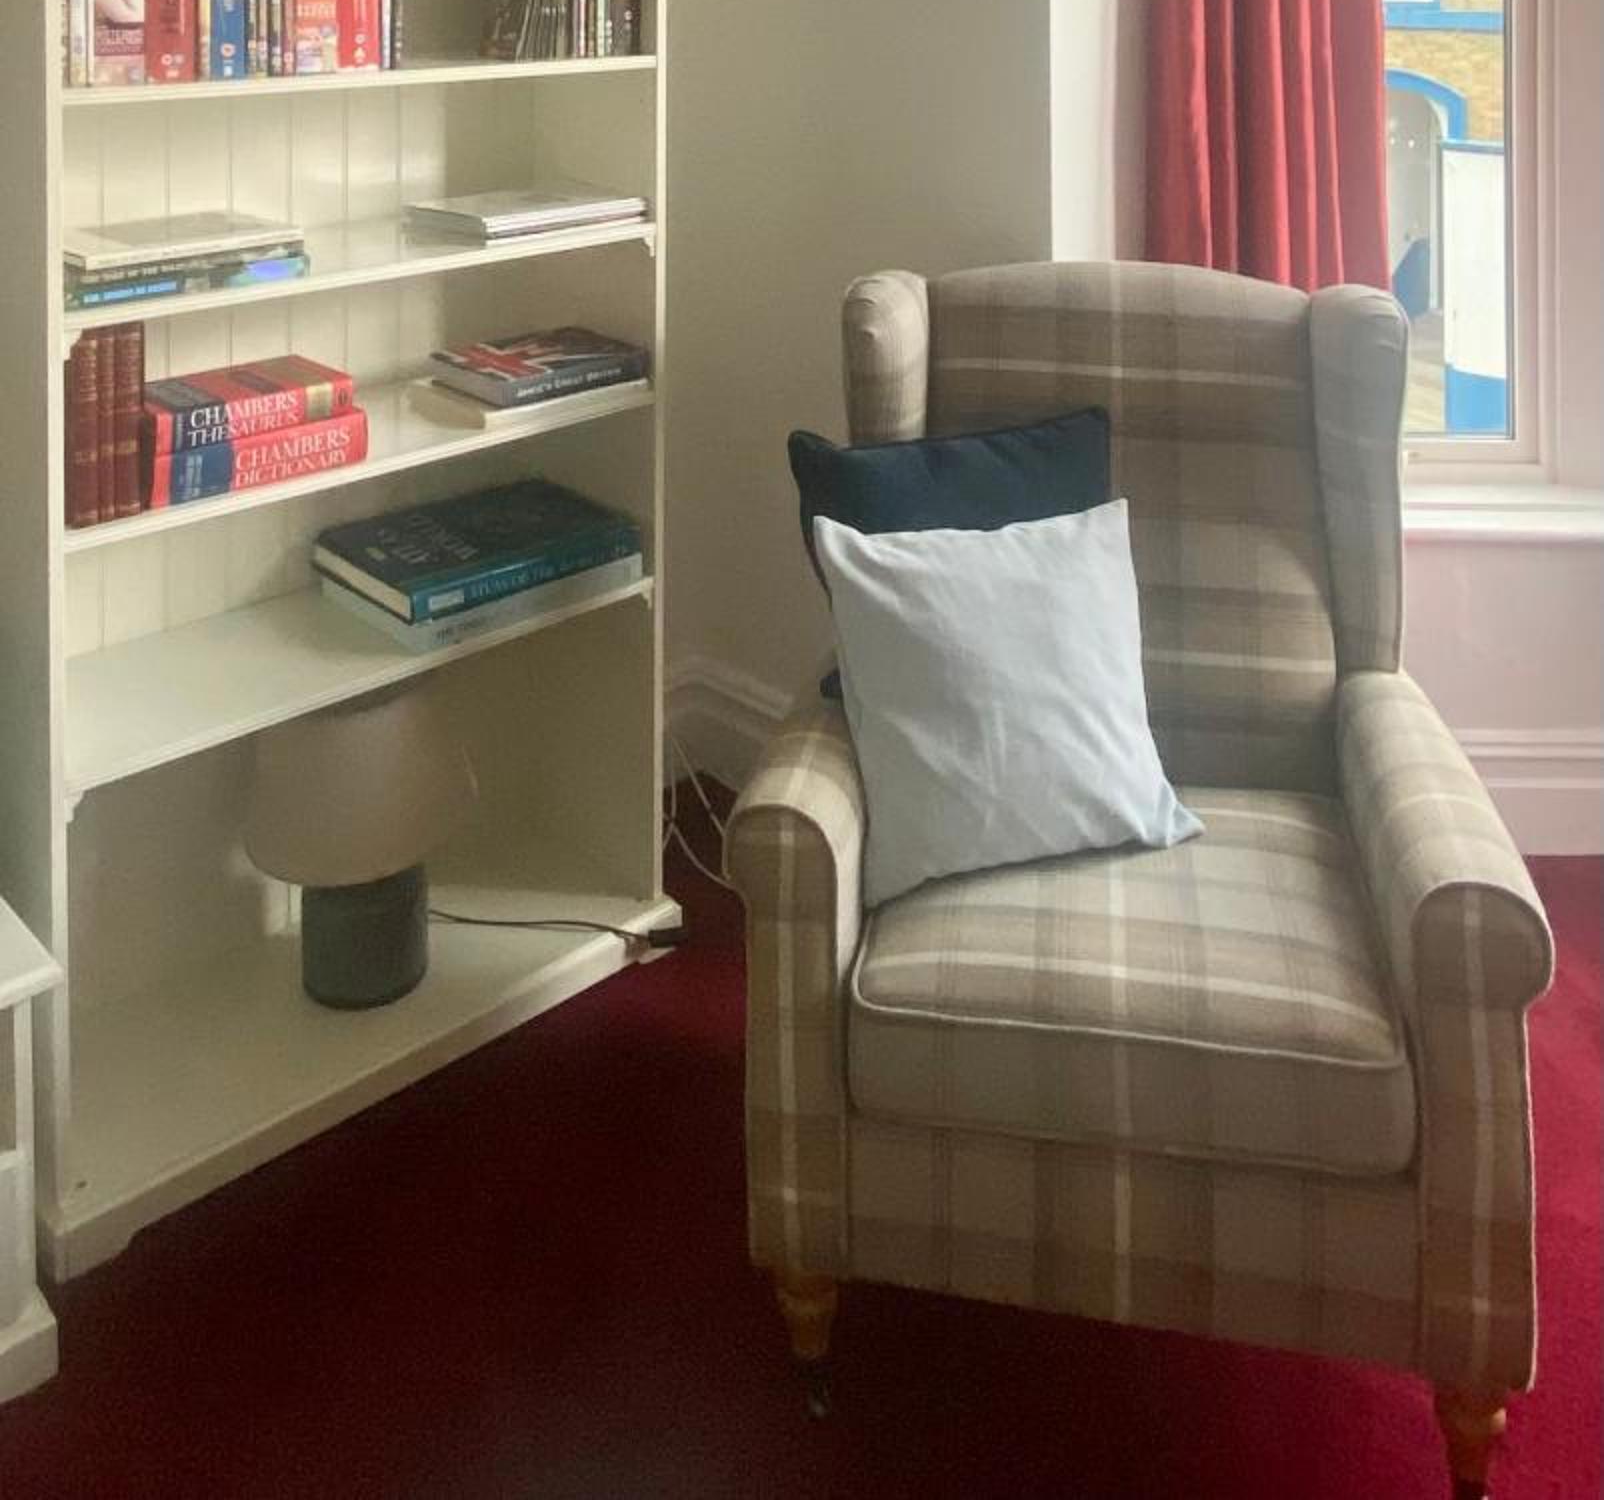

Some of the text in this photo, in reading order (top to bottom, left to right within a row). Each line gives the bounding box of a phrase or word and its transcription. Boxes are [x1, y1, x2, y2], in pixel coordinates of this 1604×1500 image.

[187, 411, 300, 447] THESAURUS
[190, 390, 298, 429] CHAMBERS
[235, 426, 351, 471] CHAMBERS
[234, 449, 347, 488] DICTIONARY
